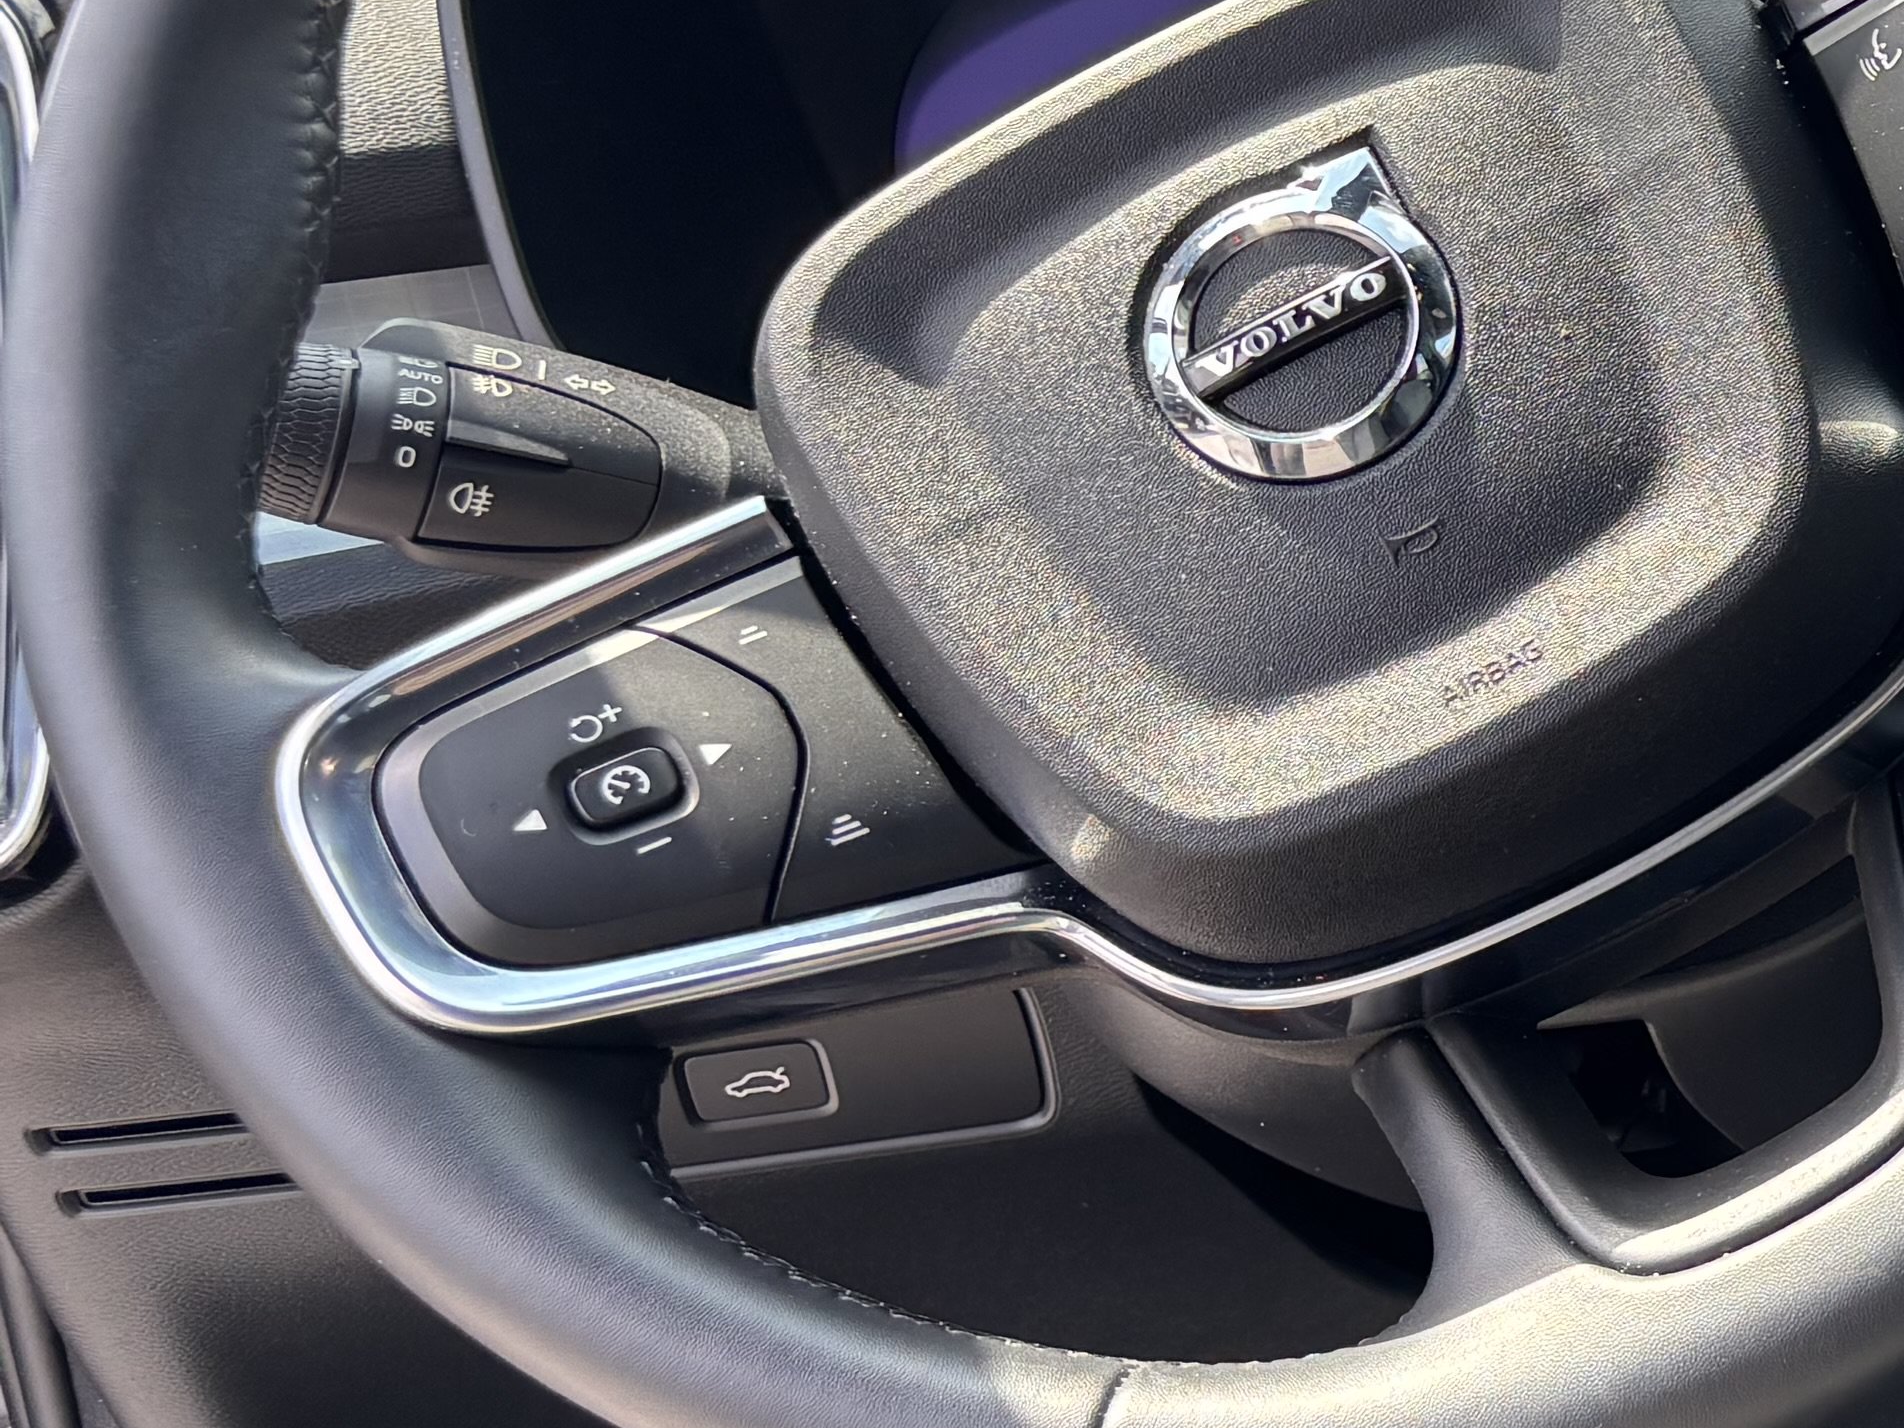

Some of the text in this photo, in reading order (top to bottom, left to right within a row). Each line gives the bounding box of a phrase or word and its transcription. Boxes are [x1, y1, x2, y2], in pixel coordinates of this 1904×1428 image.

[1195, 272, 1387, 377] VOLVO
[398, 368, 444, 385] AUTO
[1443, 638, 1544, 708] AIRBAG
